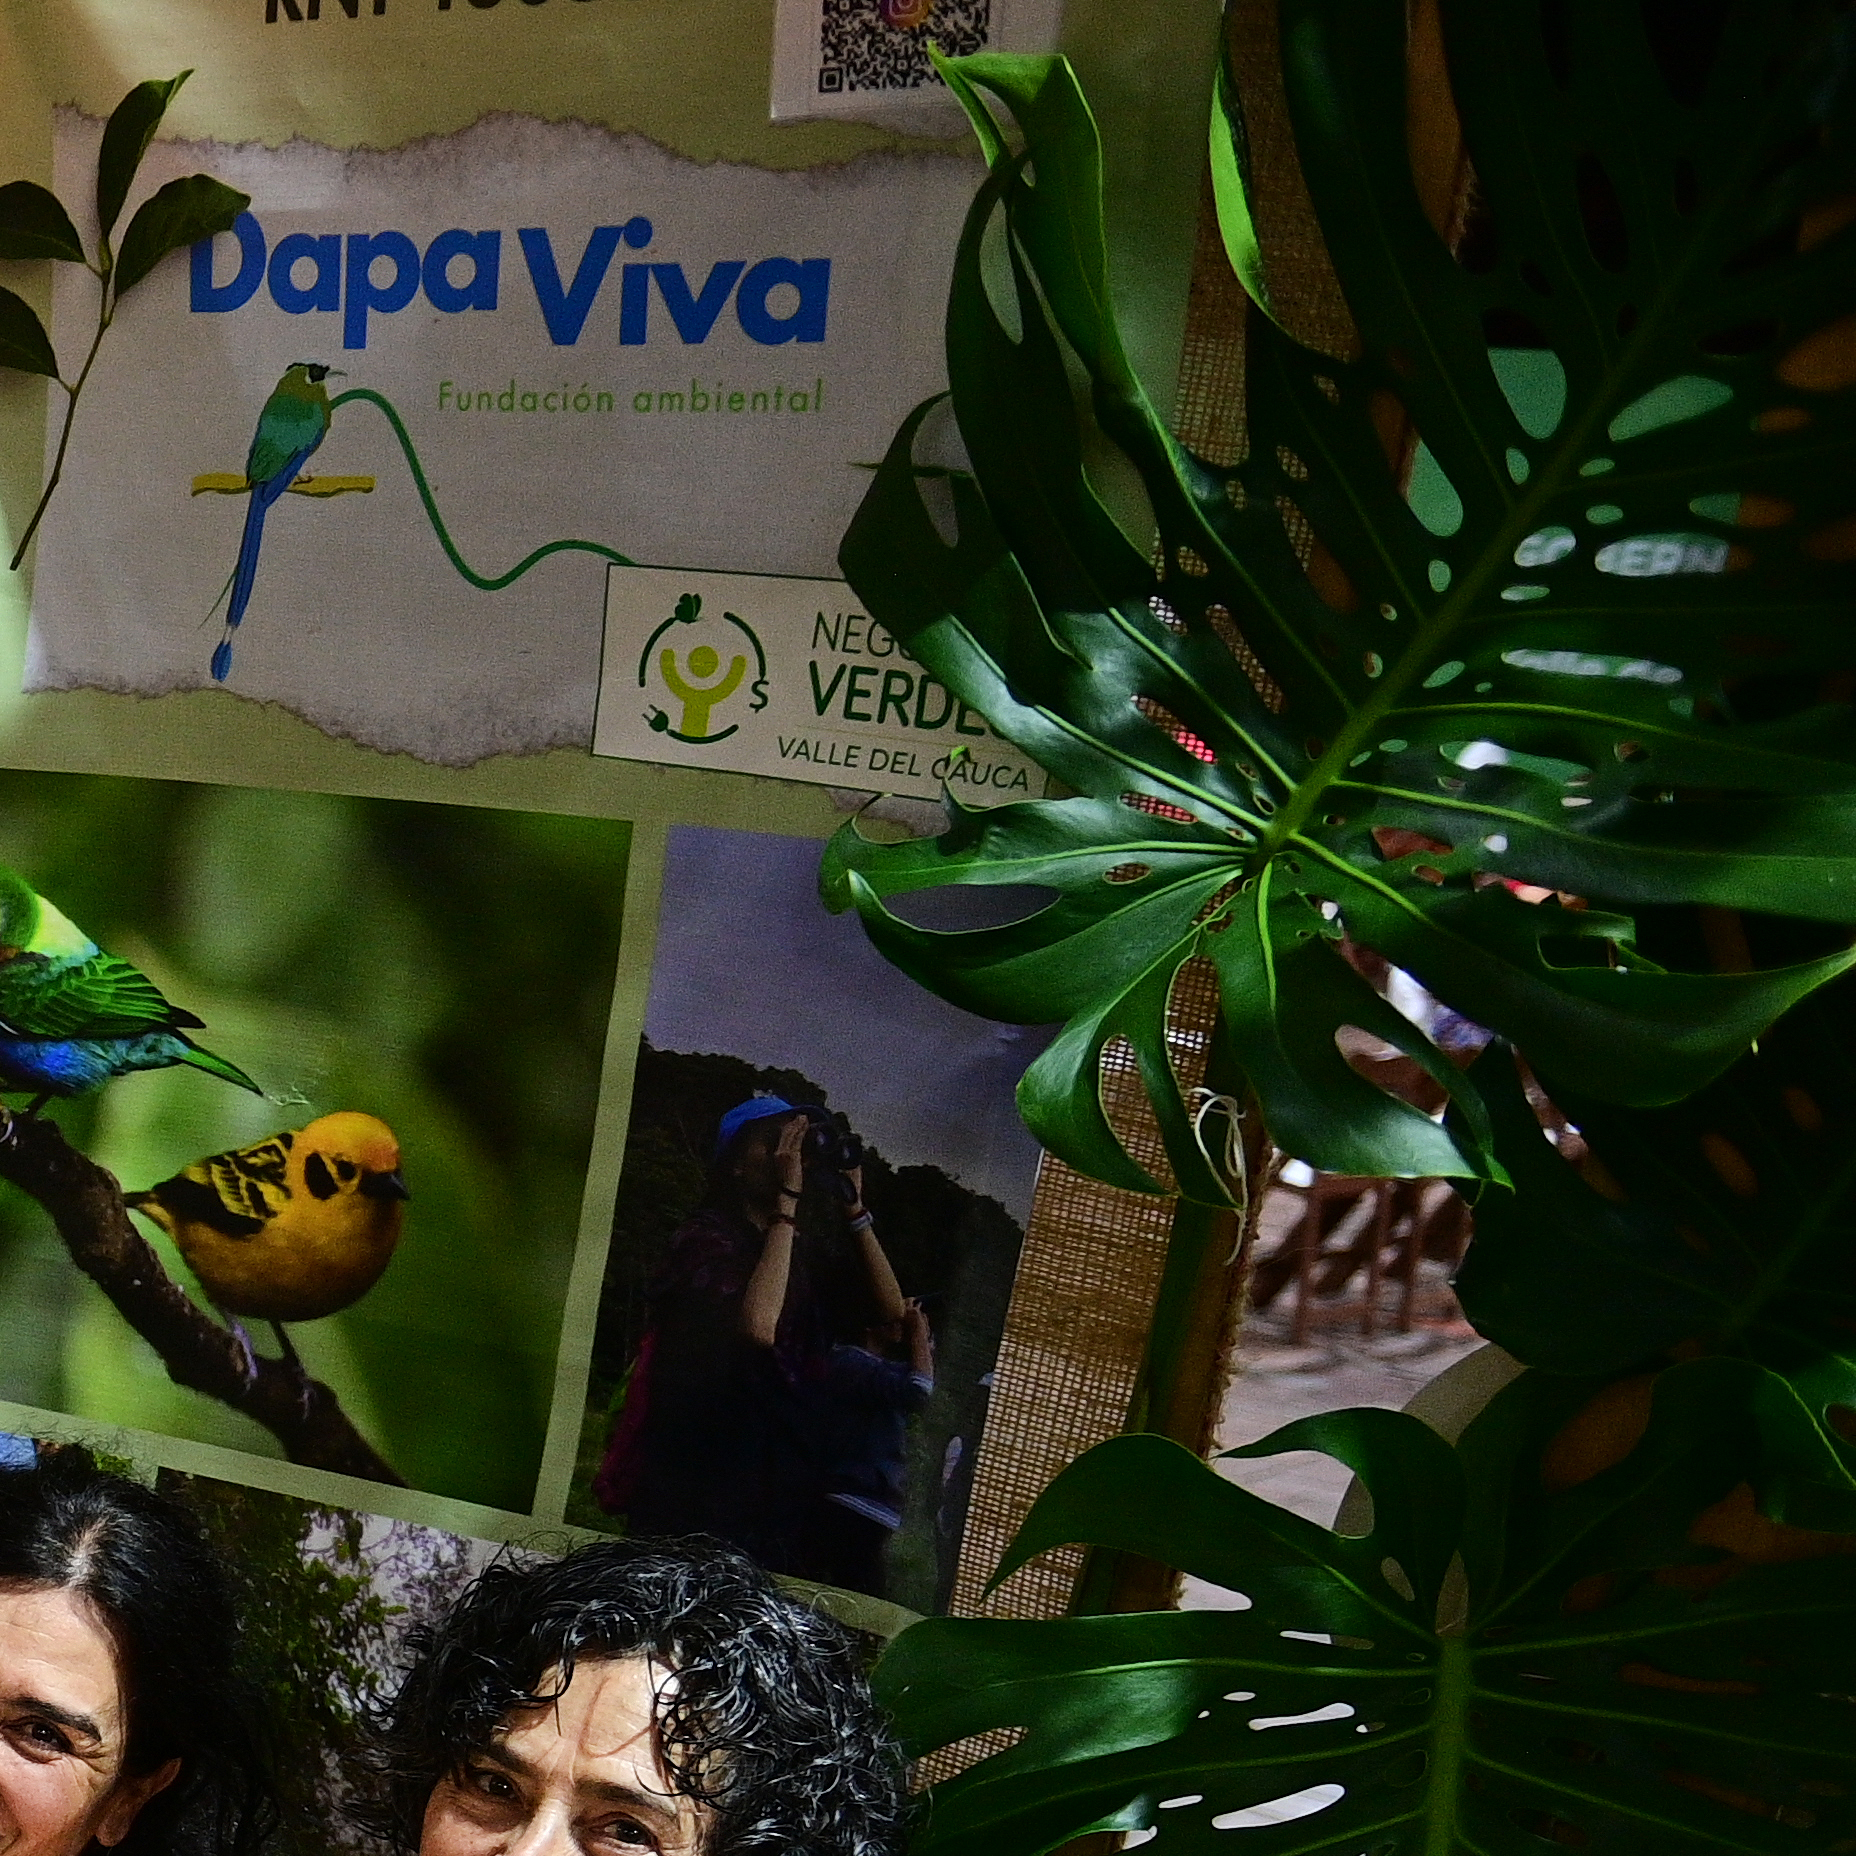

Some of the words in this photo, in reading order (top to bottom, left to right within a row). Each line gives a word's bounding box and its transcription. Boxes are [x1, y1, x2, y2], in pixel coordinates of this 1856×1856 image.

[189, 212, 502, 350] Dapa
[516, 216, 832, 347] Viva
[437, 381, 613, 414] Fundación
[632, 379, 824, 413] ambiental
[777, 735, 861, 768] VALLE
[869, 747, 921, 777] DEL
[931, 757, 1030, 791] CAUCA
